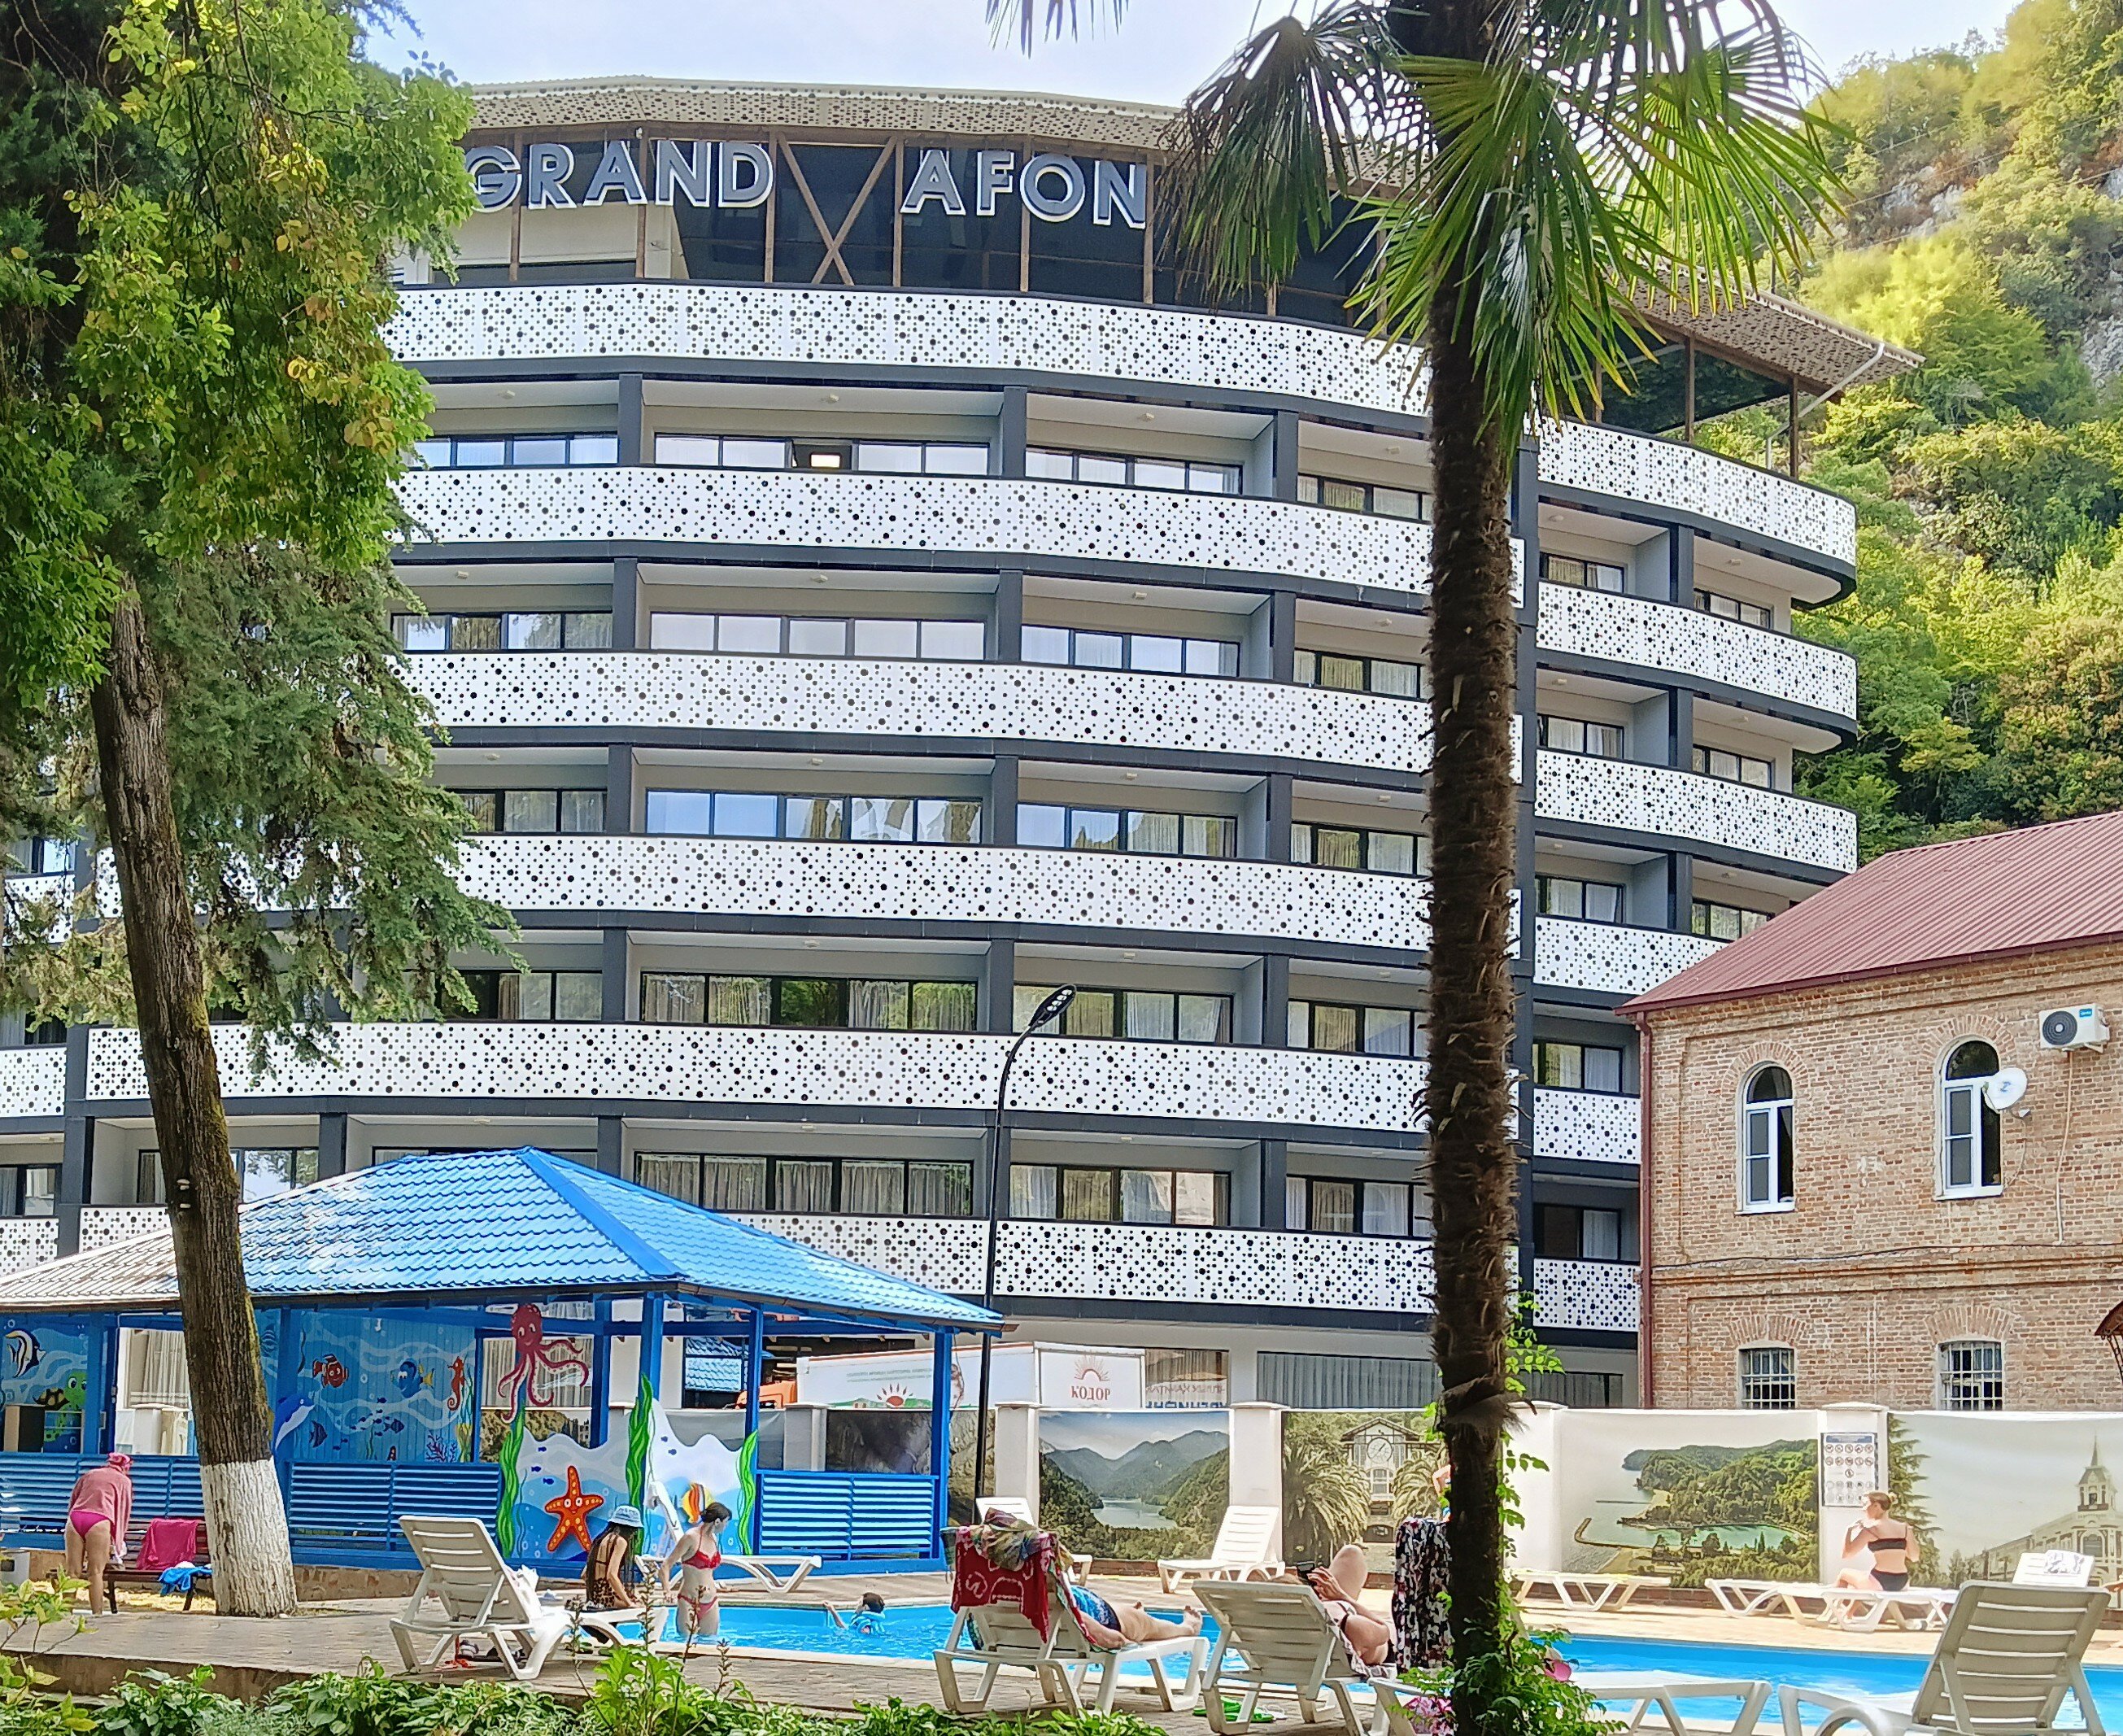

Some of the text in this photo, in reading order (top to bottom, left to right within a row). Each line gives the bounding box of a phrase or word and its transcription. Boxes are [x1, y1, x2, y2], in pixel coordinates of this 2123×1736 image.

[465, 140, 1147, 229] GRAND AFON
[1070, 1385, 1111, 1401] КОДОР
